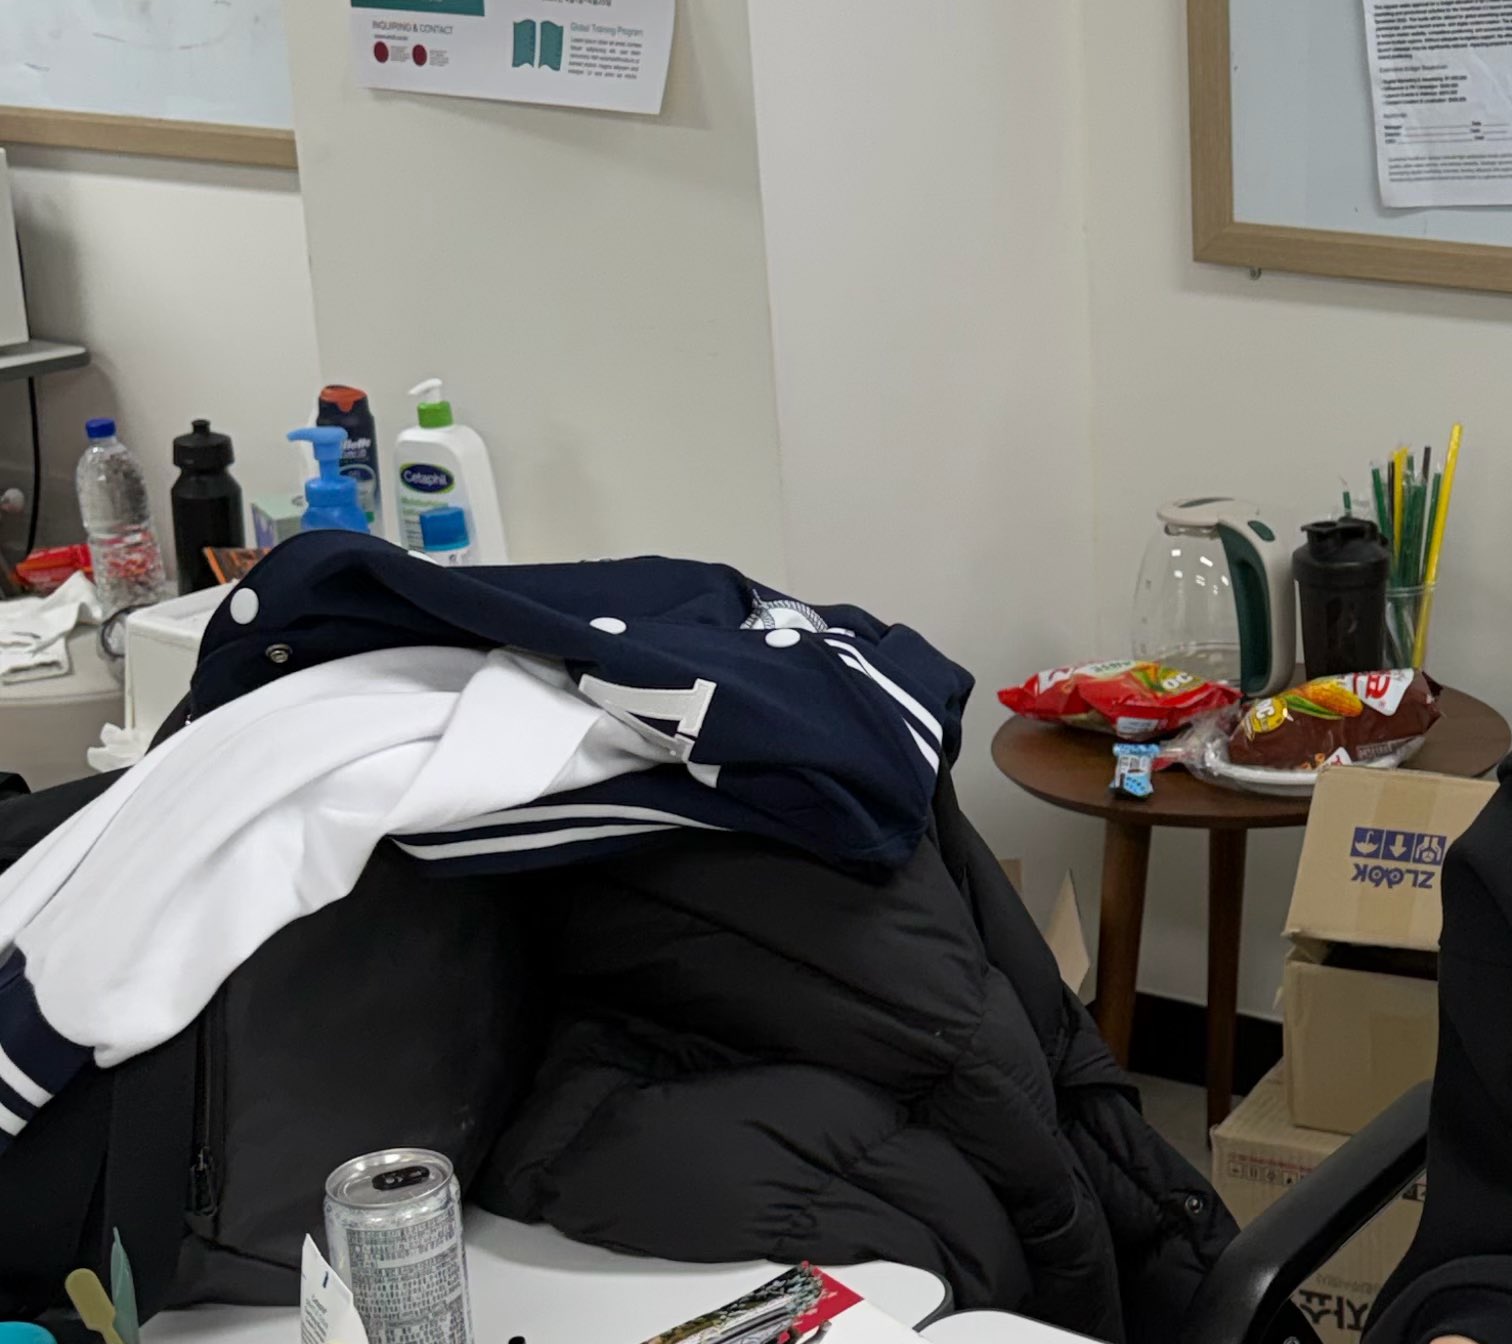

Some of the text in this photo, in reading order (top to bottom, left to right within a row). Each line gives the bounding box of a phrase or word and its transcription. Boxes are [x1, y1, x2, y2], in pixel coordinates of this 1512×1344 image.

[420, 24, 453, 34] CONTACT
[570, 22, 590, 32] Global
[618, 26, 643, 37] Program
[402, 470, 447, 487] Cetaphil
